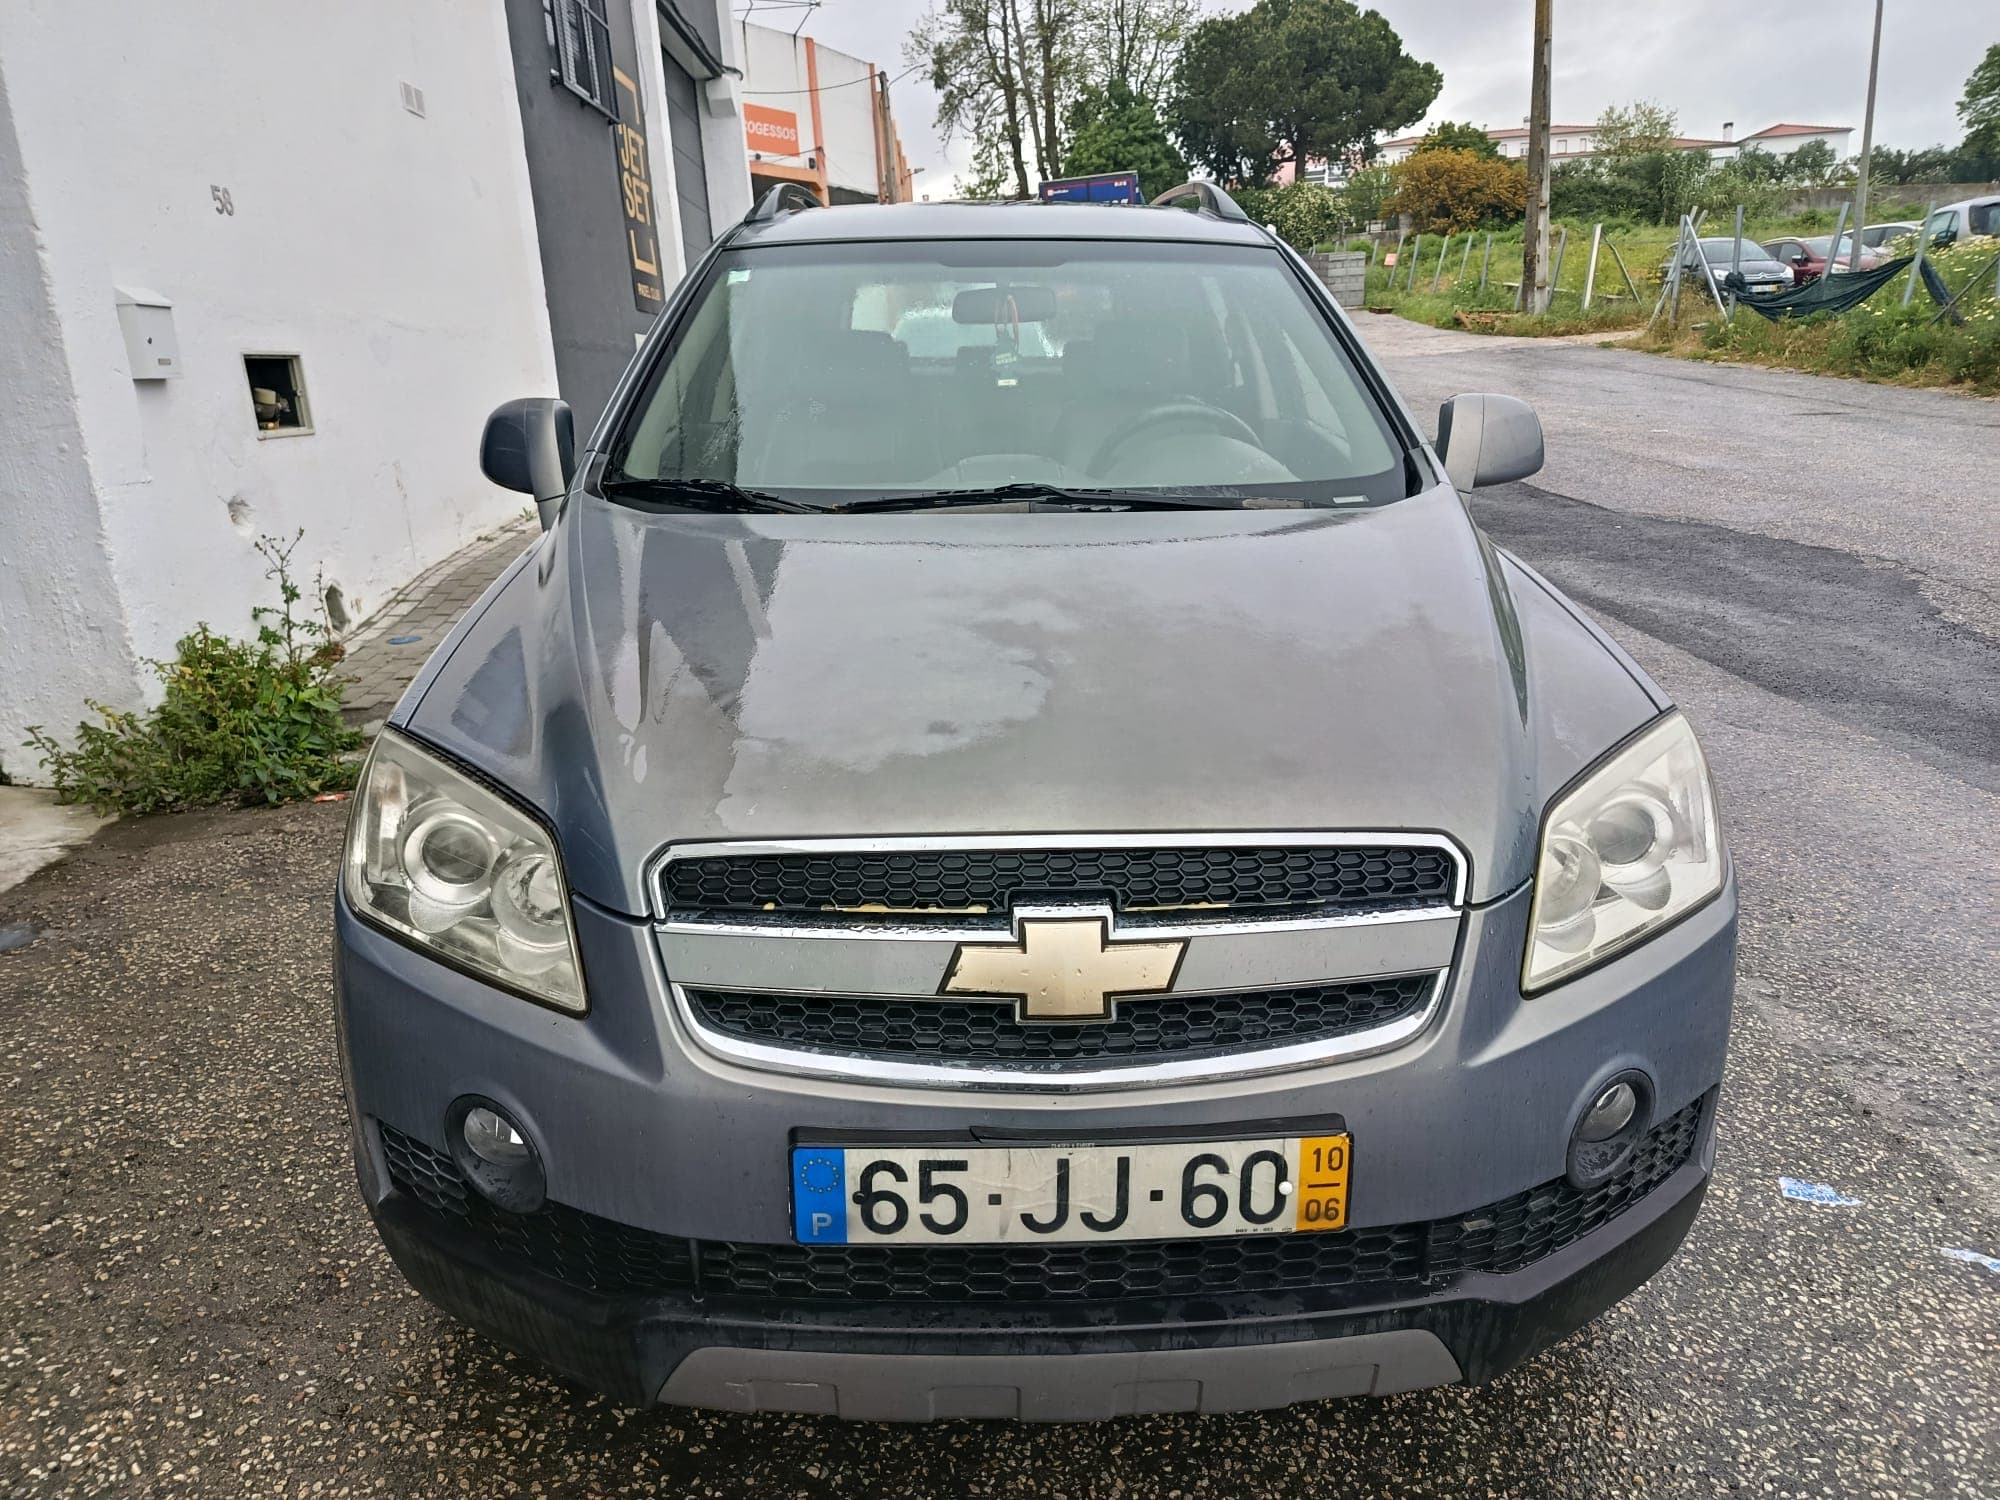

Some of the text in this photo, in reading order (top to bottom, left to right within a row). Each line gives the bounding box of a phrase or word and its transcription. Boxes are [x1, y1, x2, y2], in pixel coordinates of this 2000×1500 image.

[746, 120, 796, 141] OGESSOS
[618, 122, 645, 180] JET
[210, 184, 234, 216] 58
[623, 170, 651, 226] SET
[1312, 1146, 1344, 1173] 10
[1304, 1197, 1340, 1222] 06
[812, 1212, 832, 1236] P
